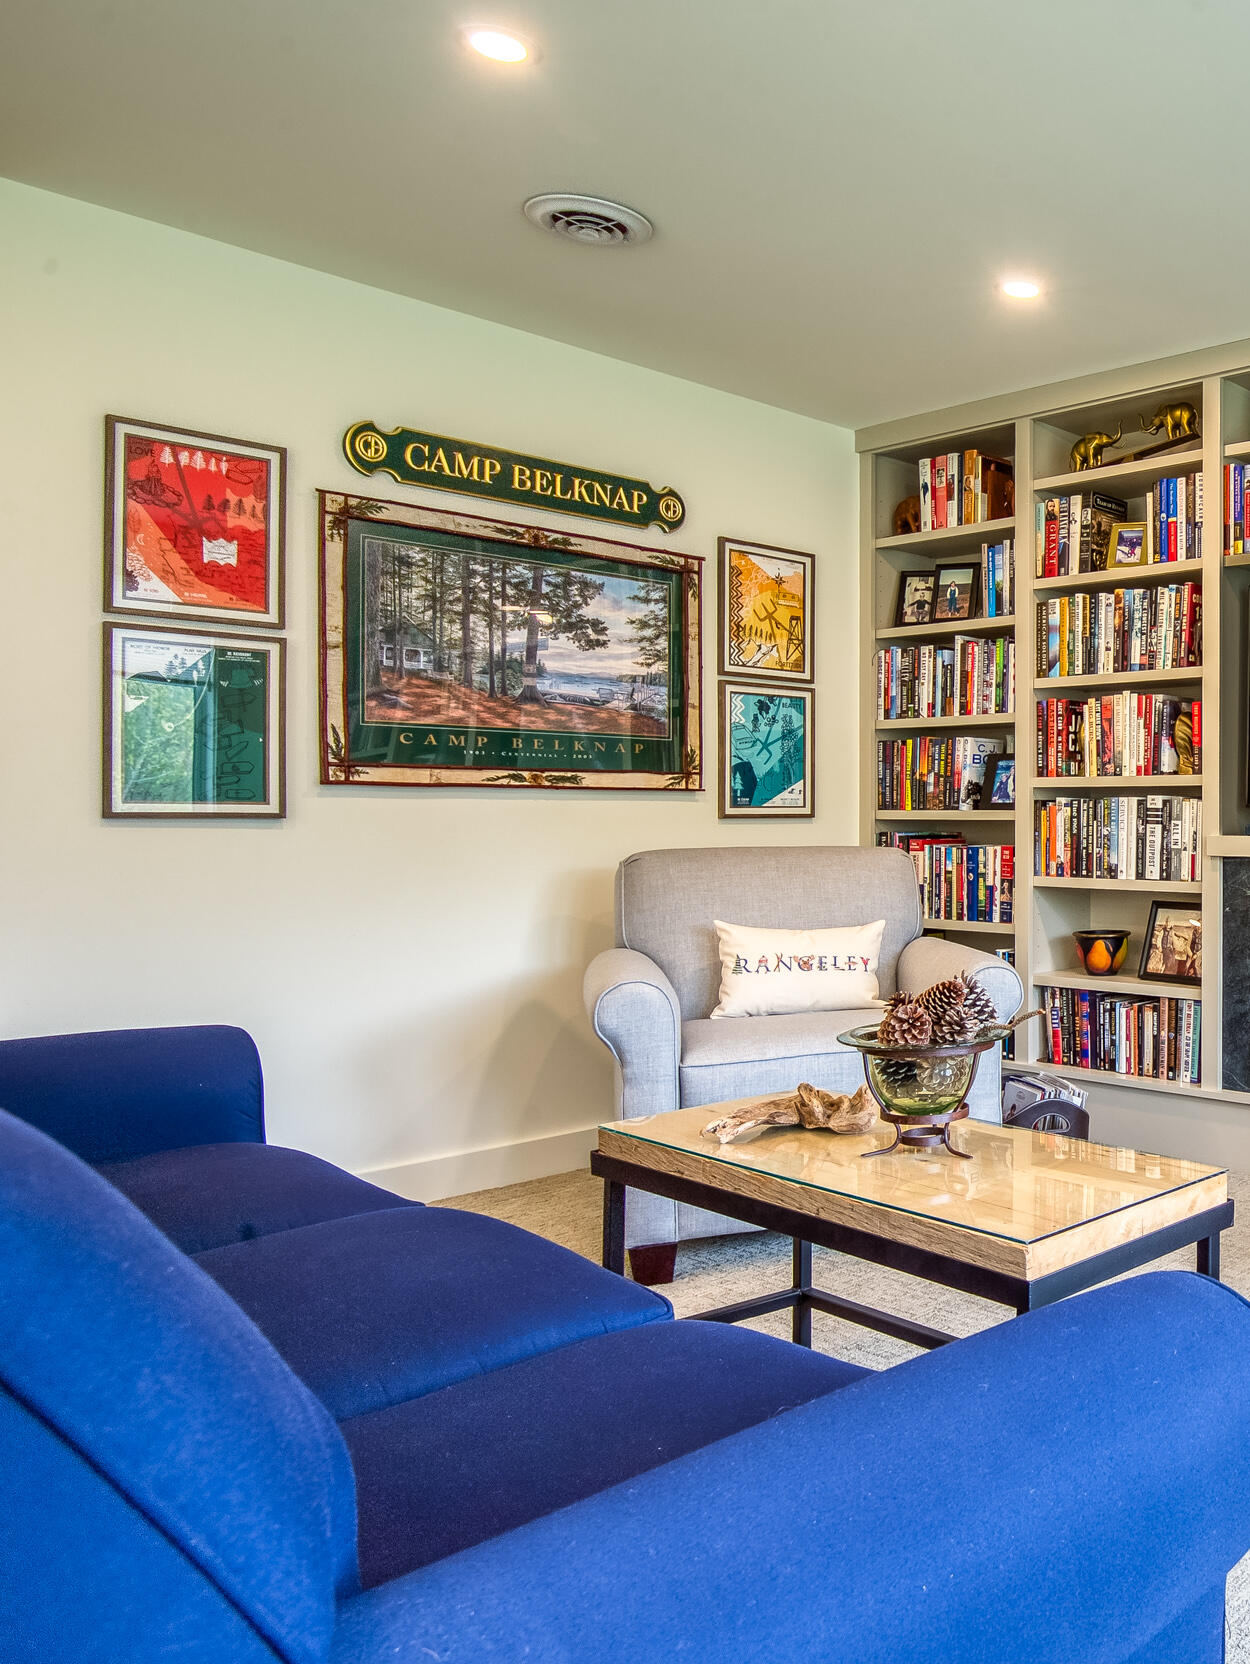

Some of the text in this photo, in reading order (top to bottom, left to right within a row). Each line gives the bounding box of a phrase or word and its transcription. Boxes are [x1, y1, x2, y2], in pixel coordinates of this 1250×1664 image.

[129, 446, 155, 457] LOVE
[404, 442, 648, 514] CAMP BELKNAP
[1049, 524, 1057, 565] GRANT
[901, 657, 909, 681] VALLEY
[399, 732, 645, 754] CAMP BELKNAP
[1172, 838, 1179, 846] IN
[731, 952, 871, 976] RANGELEY
